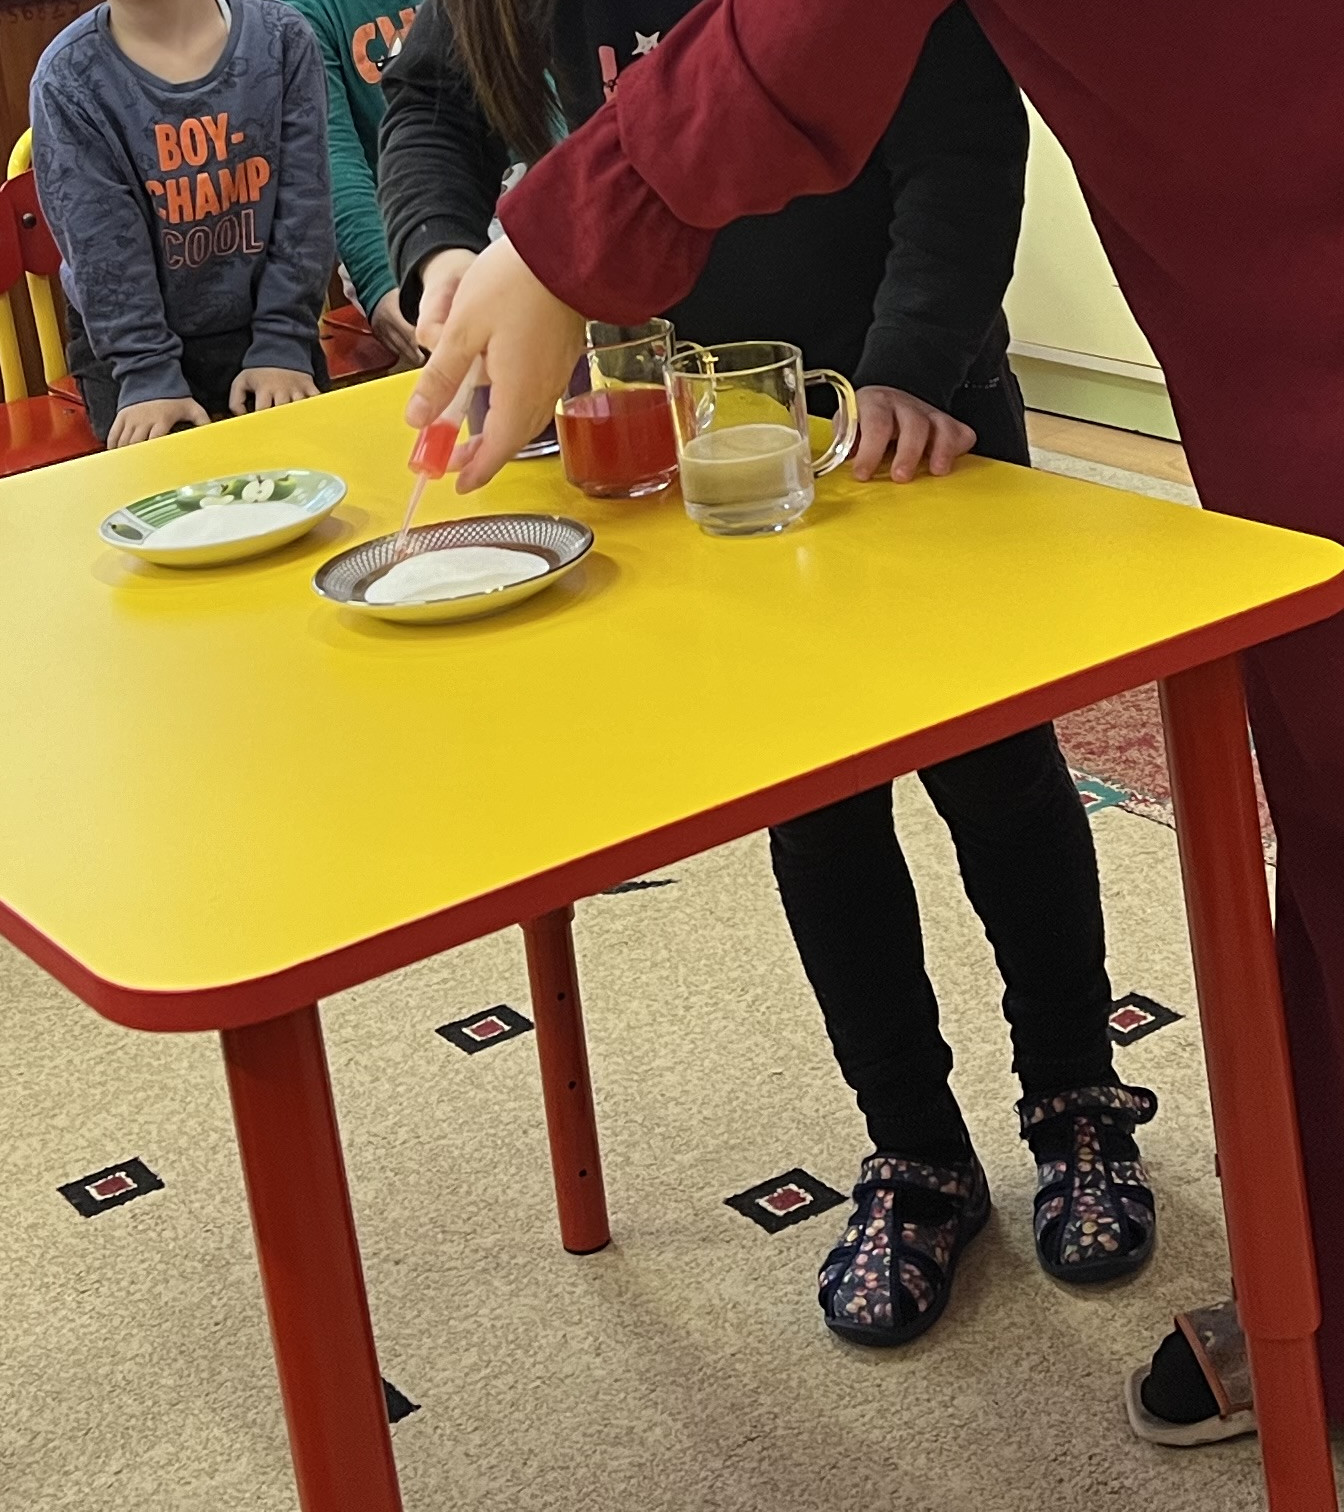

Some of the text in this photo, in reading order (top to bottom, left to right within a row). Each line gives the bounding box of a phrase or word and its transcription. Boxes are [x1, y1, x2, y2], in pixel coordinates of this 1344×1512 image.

[155, 112, 244, 172] BOY-
[145, 156, 271, 224] CHAMP
[161, 208, 264, 270] COOL
